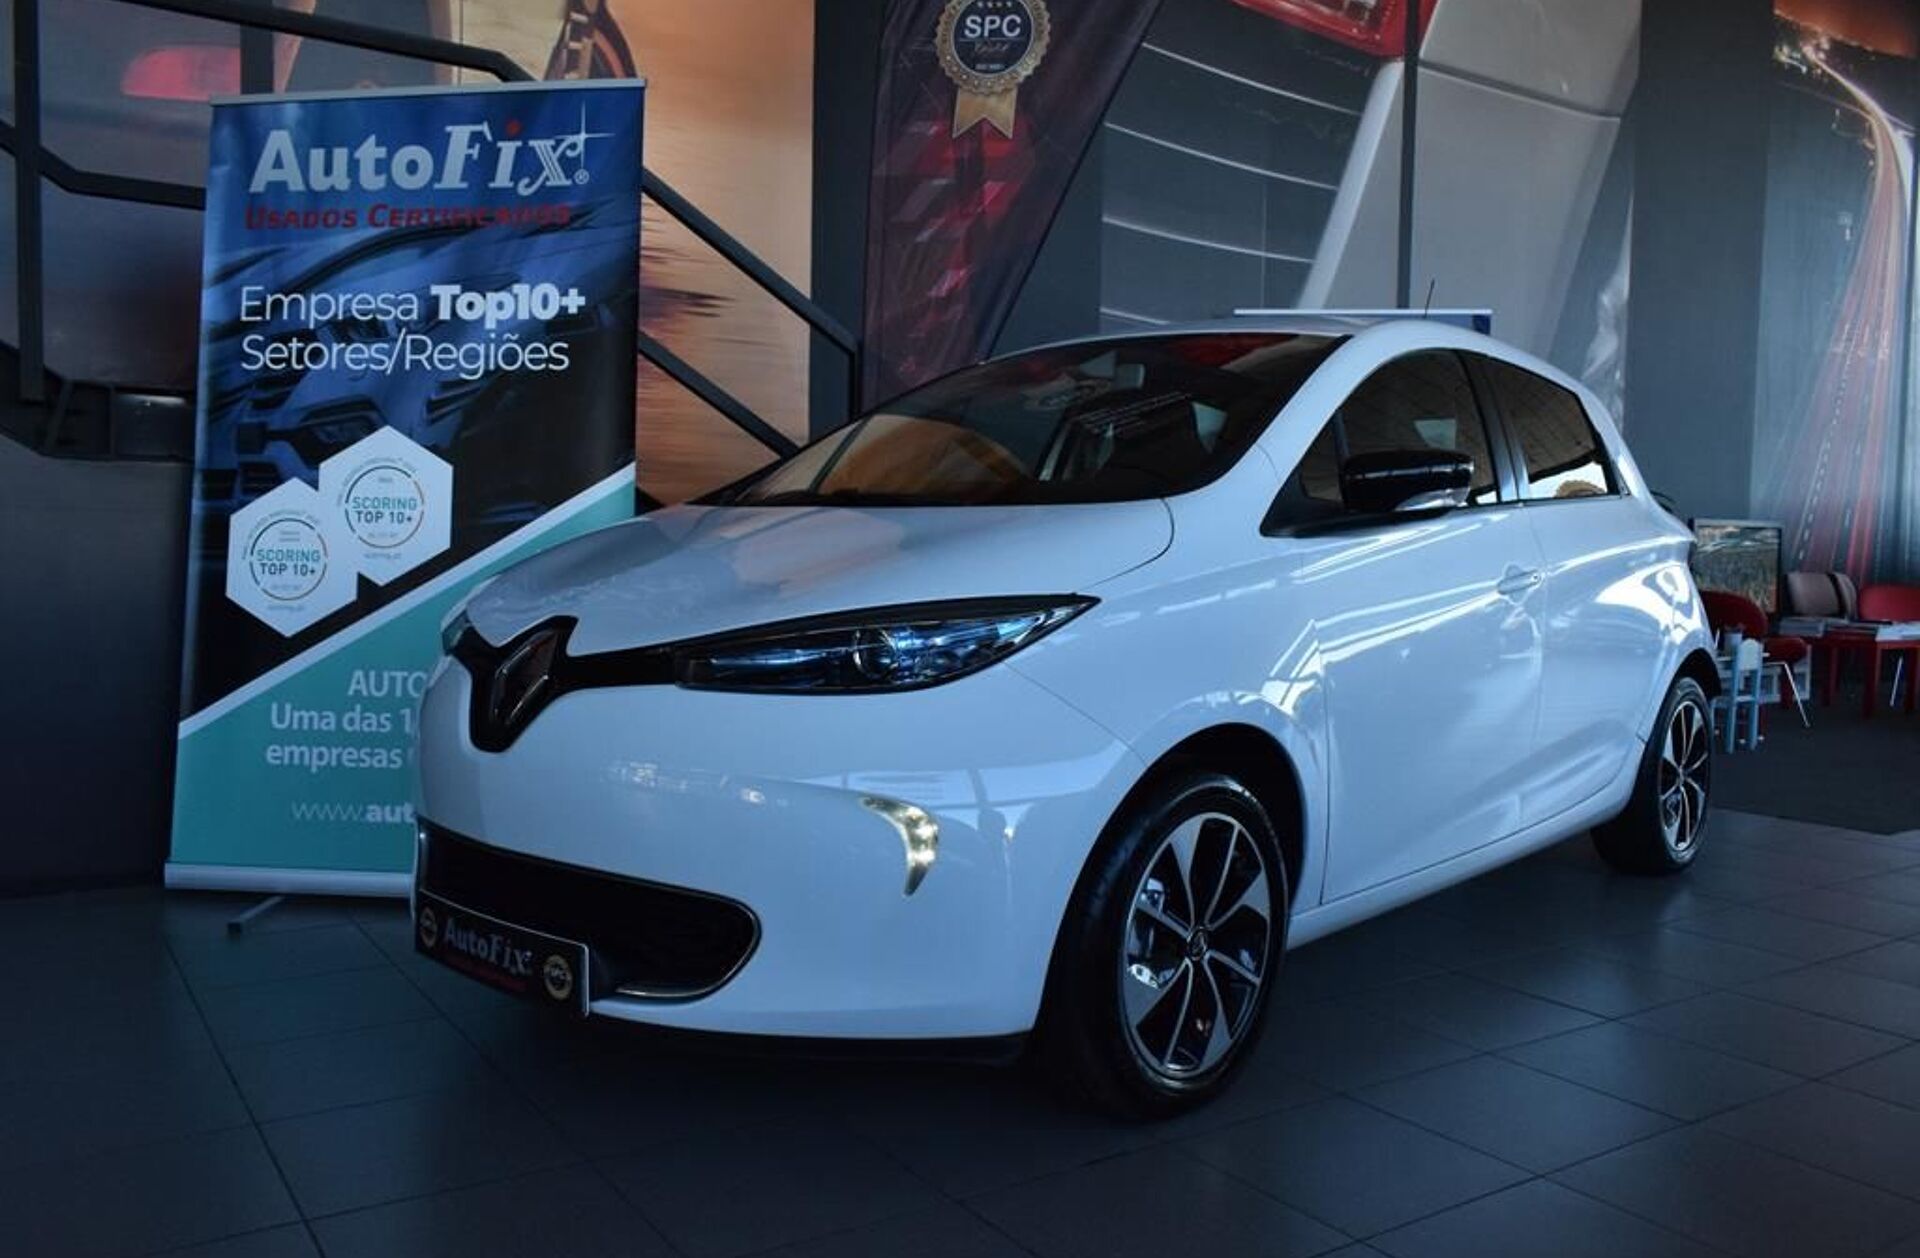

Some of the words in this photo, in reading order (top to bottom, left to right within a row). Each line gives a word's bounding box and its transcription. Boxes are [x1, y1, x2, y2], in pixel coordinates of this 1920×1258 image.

[964, 14, 1022, 39] SPC
[241, 285, 419, 329] Empresa
[430, 282, 586, 329] Top10+
[240, 328, 570, 380] Setores/Regiões
[351, 495, 418, 512] SCORING
[355, 510, 383, 524] TOP
[388, 510, 414, 525] 10+
[256, 548, 321, 563] SCORING
[259, 562, 288, 576] TOP
[293, 562, 316, 577] 10+
[270, 702, 336, 731] Uma
[342, 703, 392, 733] das
[265, 744, 402, 773] empresas
